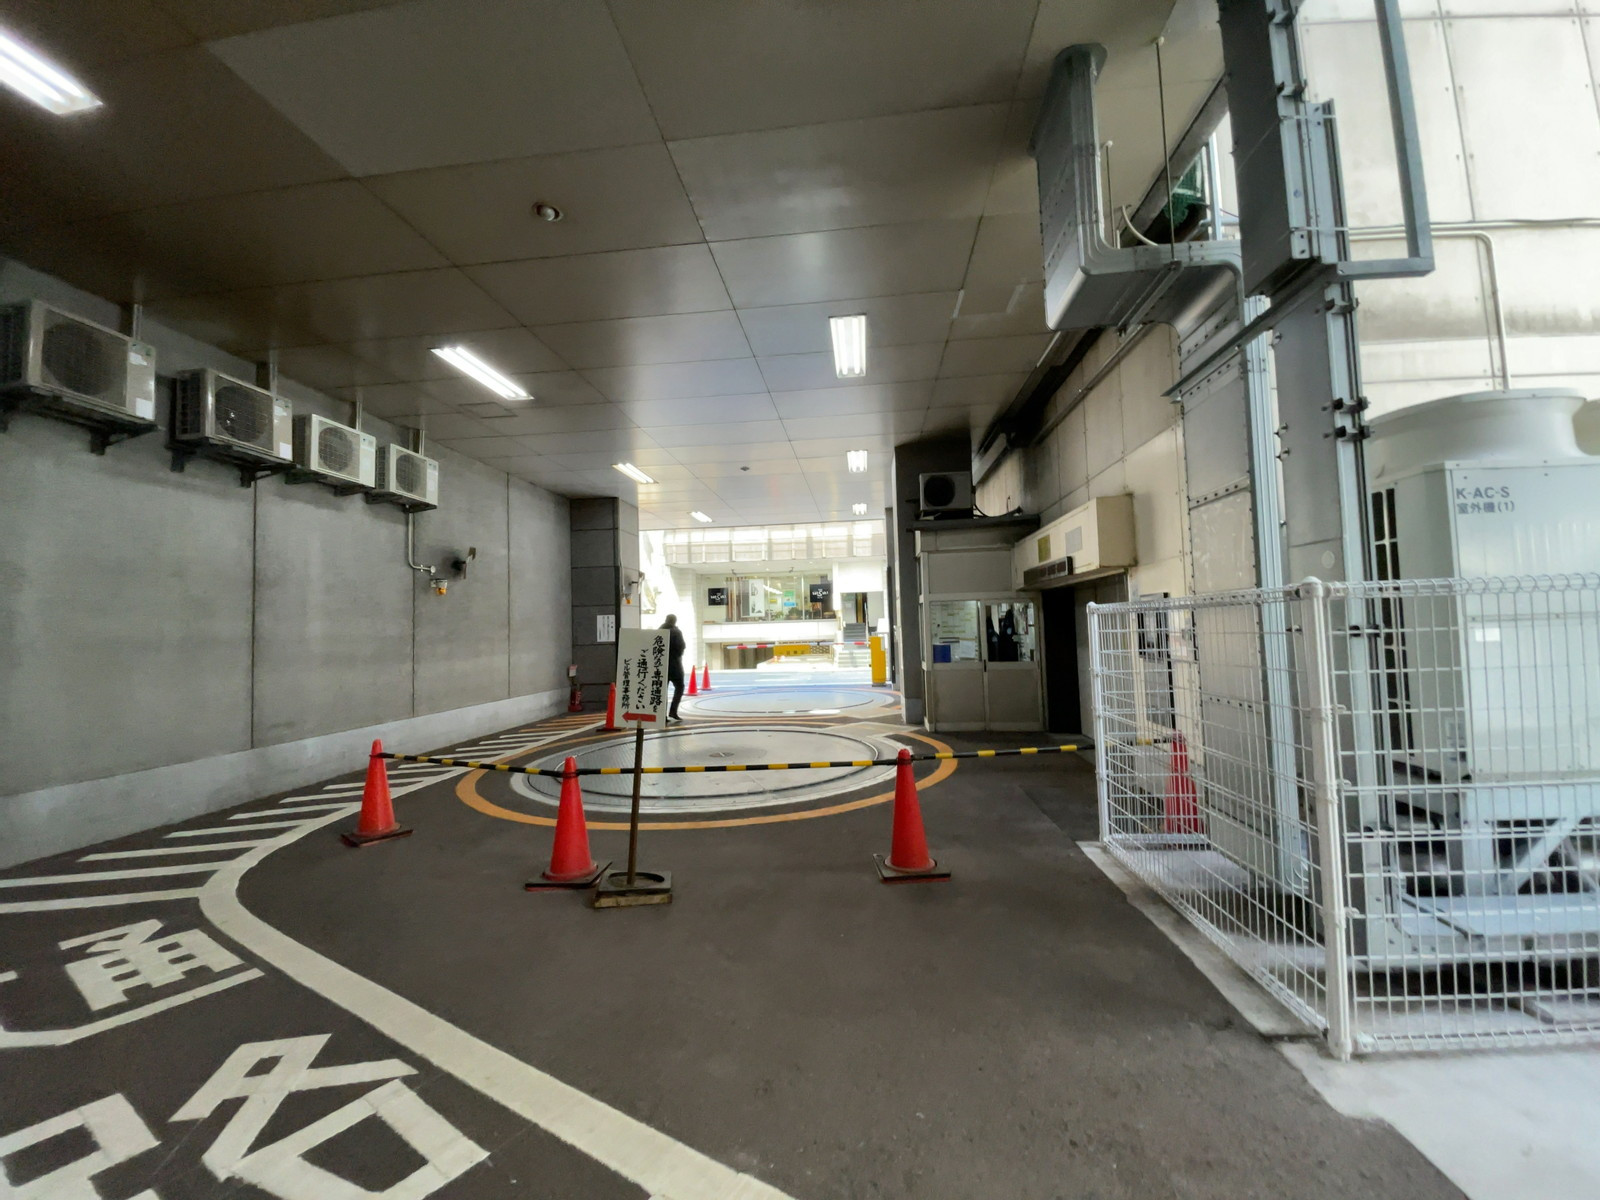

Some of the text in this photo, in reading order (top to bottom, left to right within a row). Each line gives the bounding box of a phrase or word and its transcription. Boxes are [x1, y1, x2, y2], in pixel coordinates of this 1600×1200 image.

[621, 658, 632, 710] ビル管理事務所
[635, 649, 649, 710] ご通行ください
